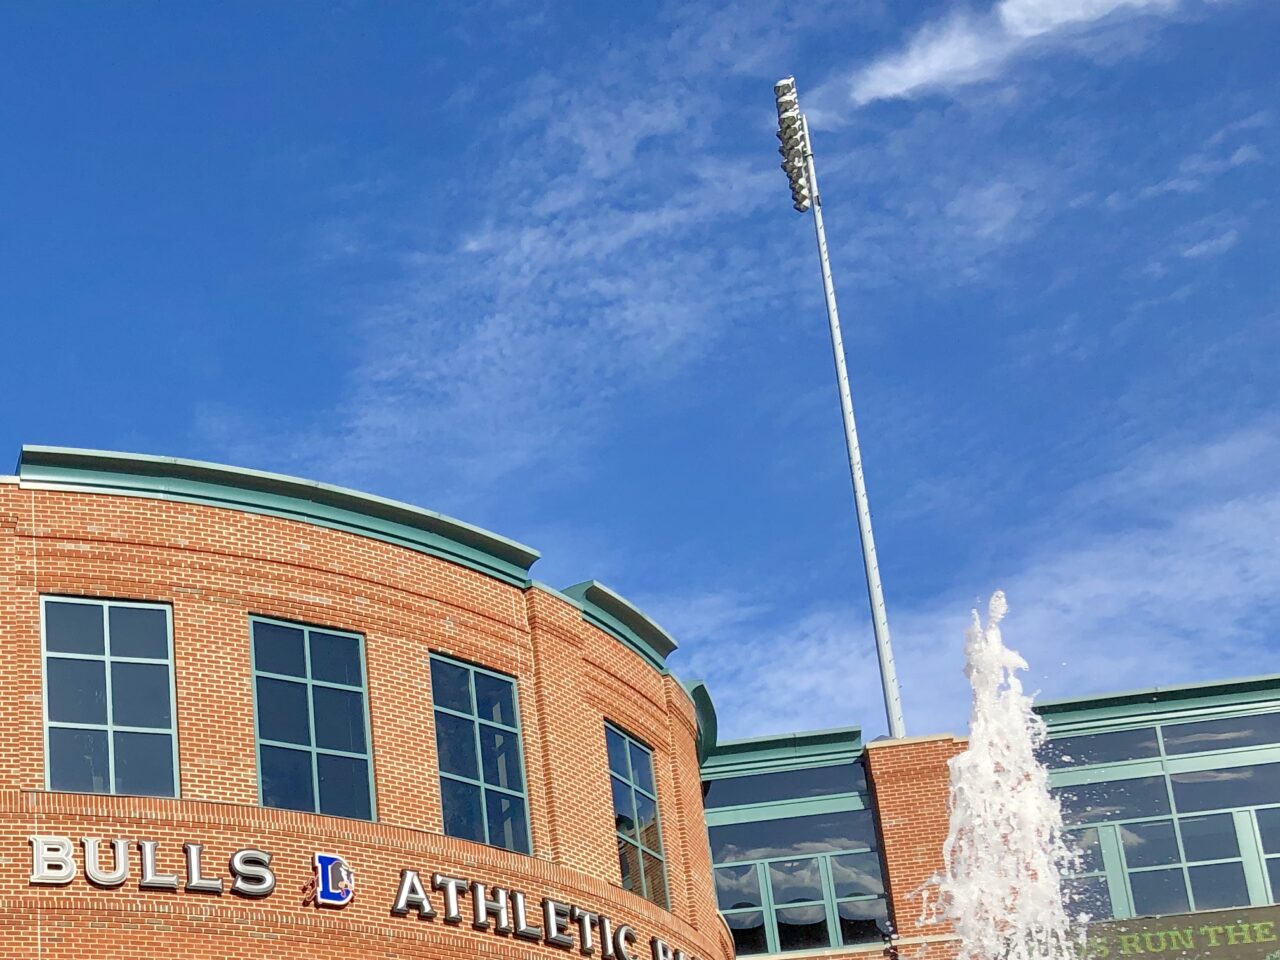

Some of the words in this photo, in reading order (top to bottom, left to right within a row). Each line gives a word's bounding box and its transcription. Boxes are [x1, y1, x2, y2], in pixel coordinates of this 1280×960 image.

[29, 834, 276, 898] BULLS
[1119, 928, 1195, 955] RUN
[1199, 921, 1277, 947] THE
